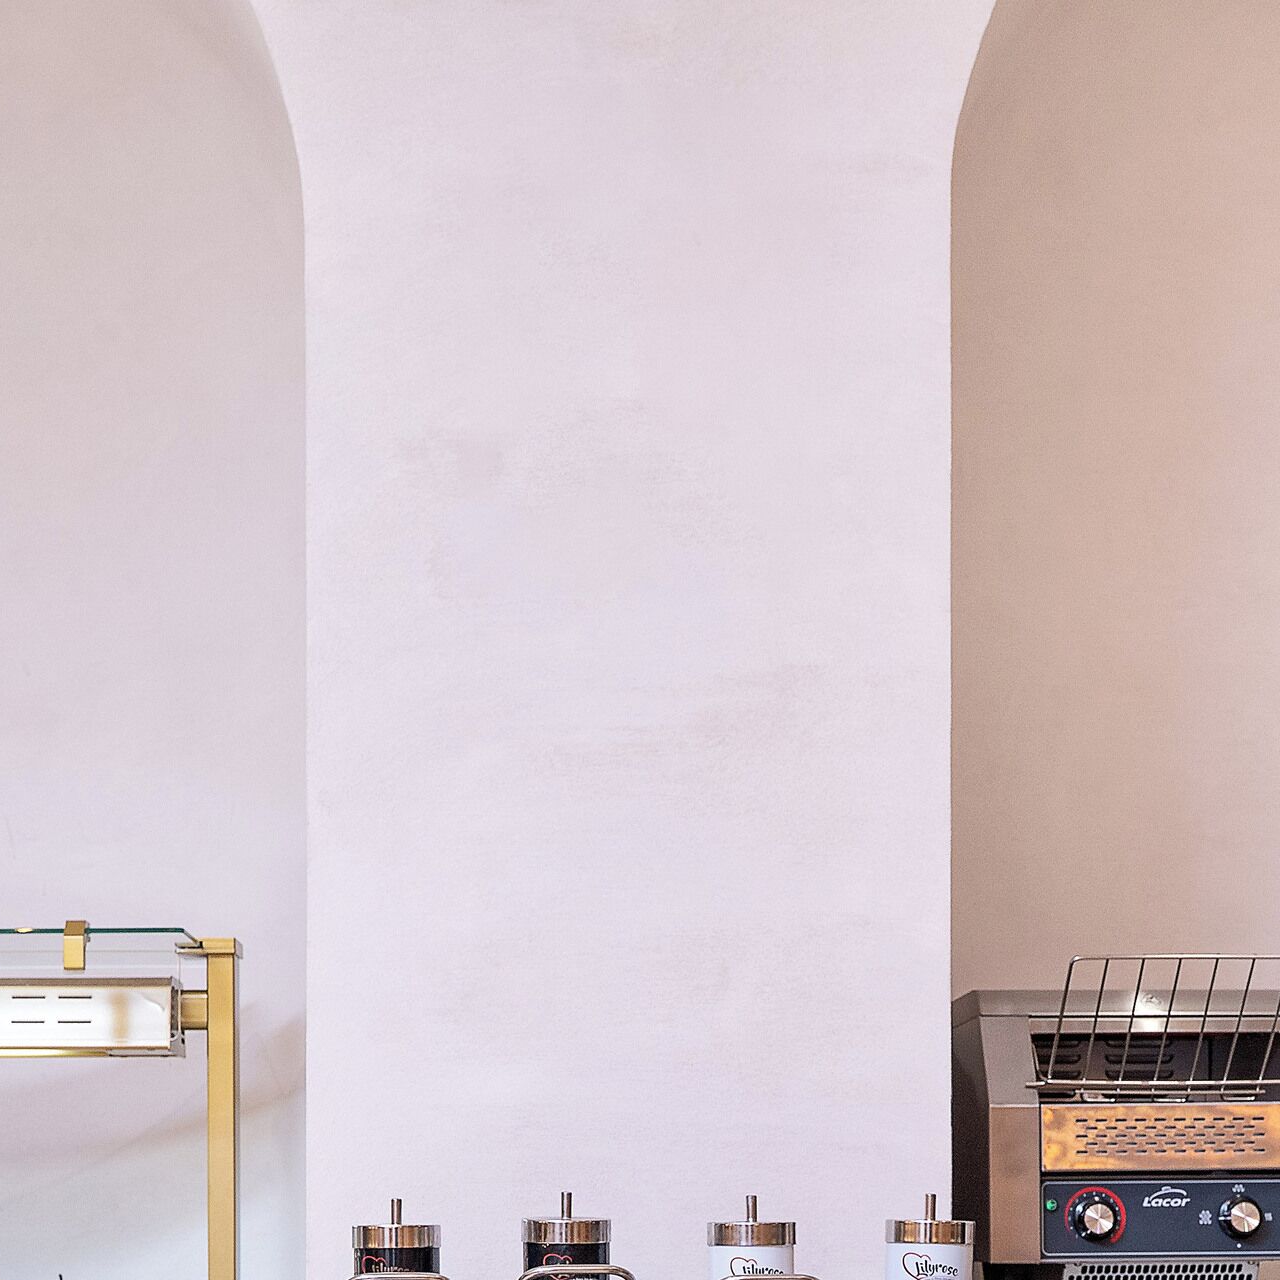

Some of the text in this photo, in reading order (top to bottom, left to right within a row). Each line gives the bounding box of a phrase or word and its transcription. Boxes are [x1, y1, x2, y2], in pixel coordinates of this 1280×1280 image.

[1142, 1196, 1191, 1208] Lacor
[742, 1263, 784, 1275] Lilyros
[915, 1260, 959, 1277] Lilyrose
